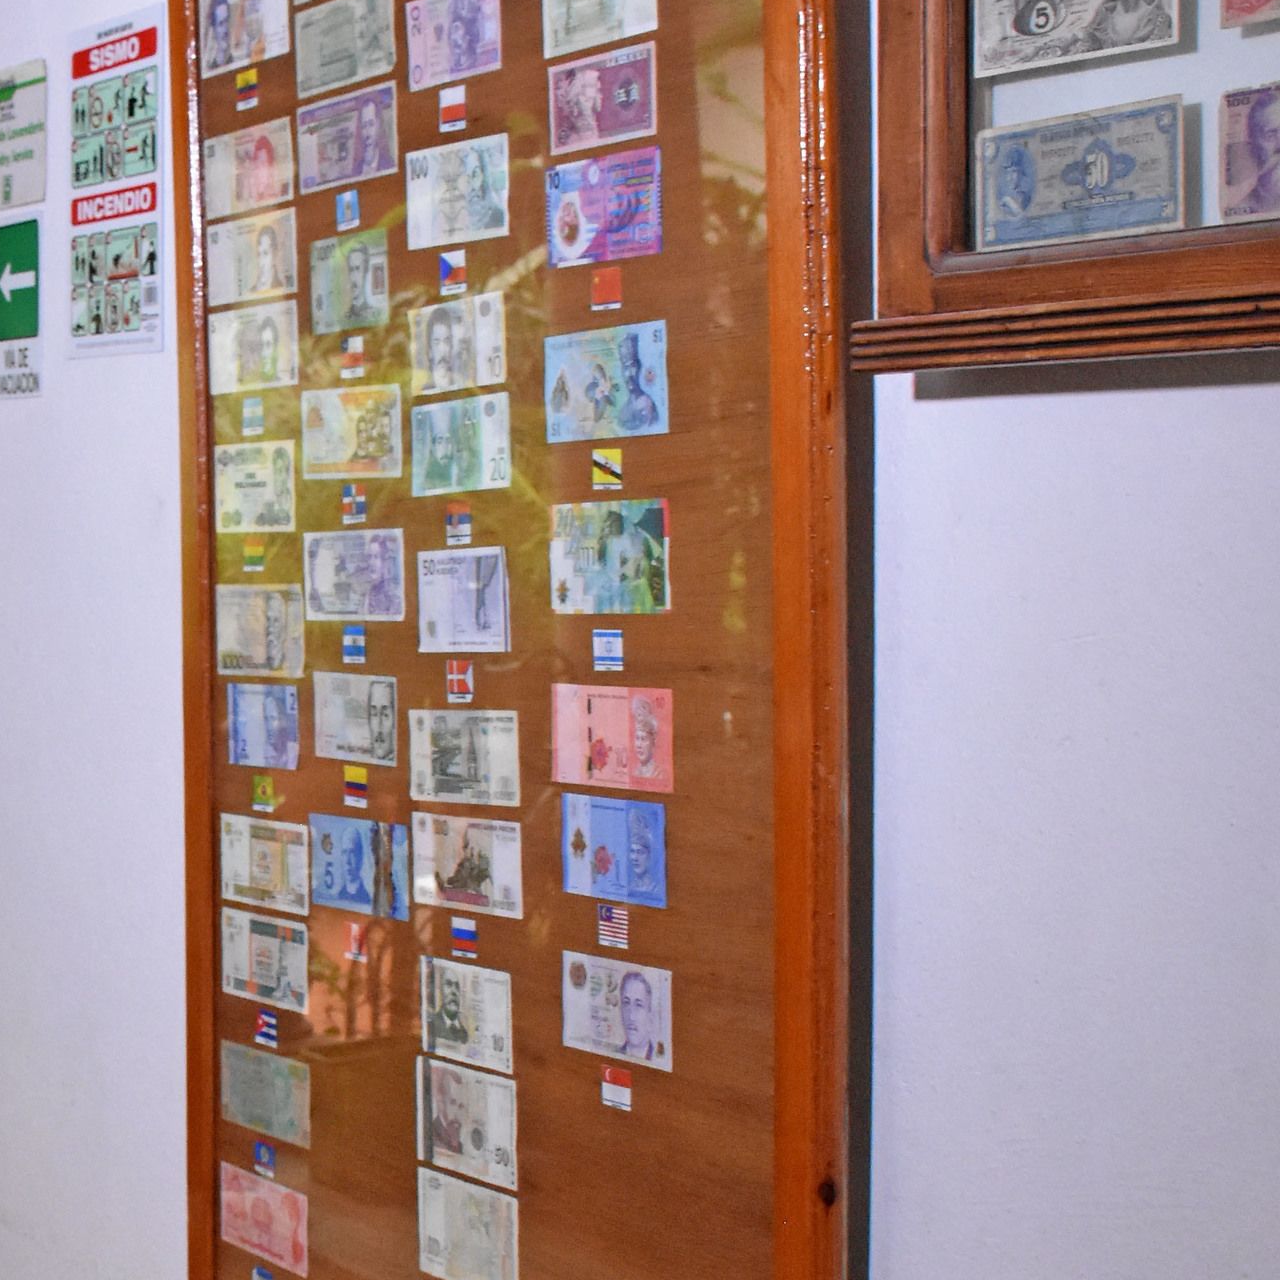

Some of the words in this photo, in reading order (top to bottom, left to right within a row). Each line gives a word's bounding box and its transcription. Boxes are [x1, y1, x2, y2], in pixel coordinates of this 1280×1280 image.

[1034, 6, 1050, 29] 5
[89, 36, 140, 71] SISMO
[1086, 150, 1109, 190] 50
[77, 186, 152, 223] INCENDIO
